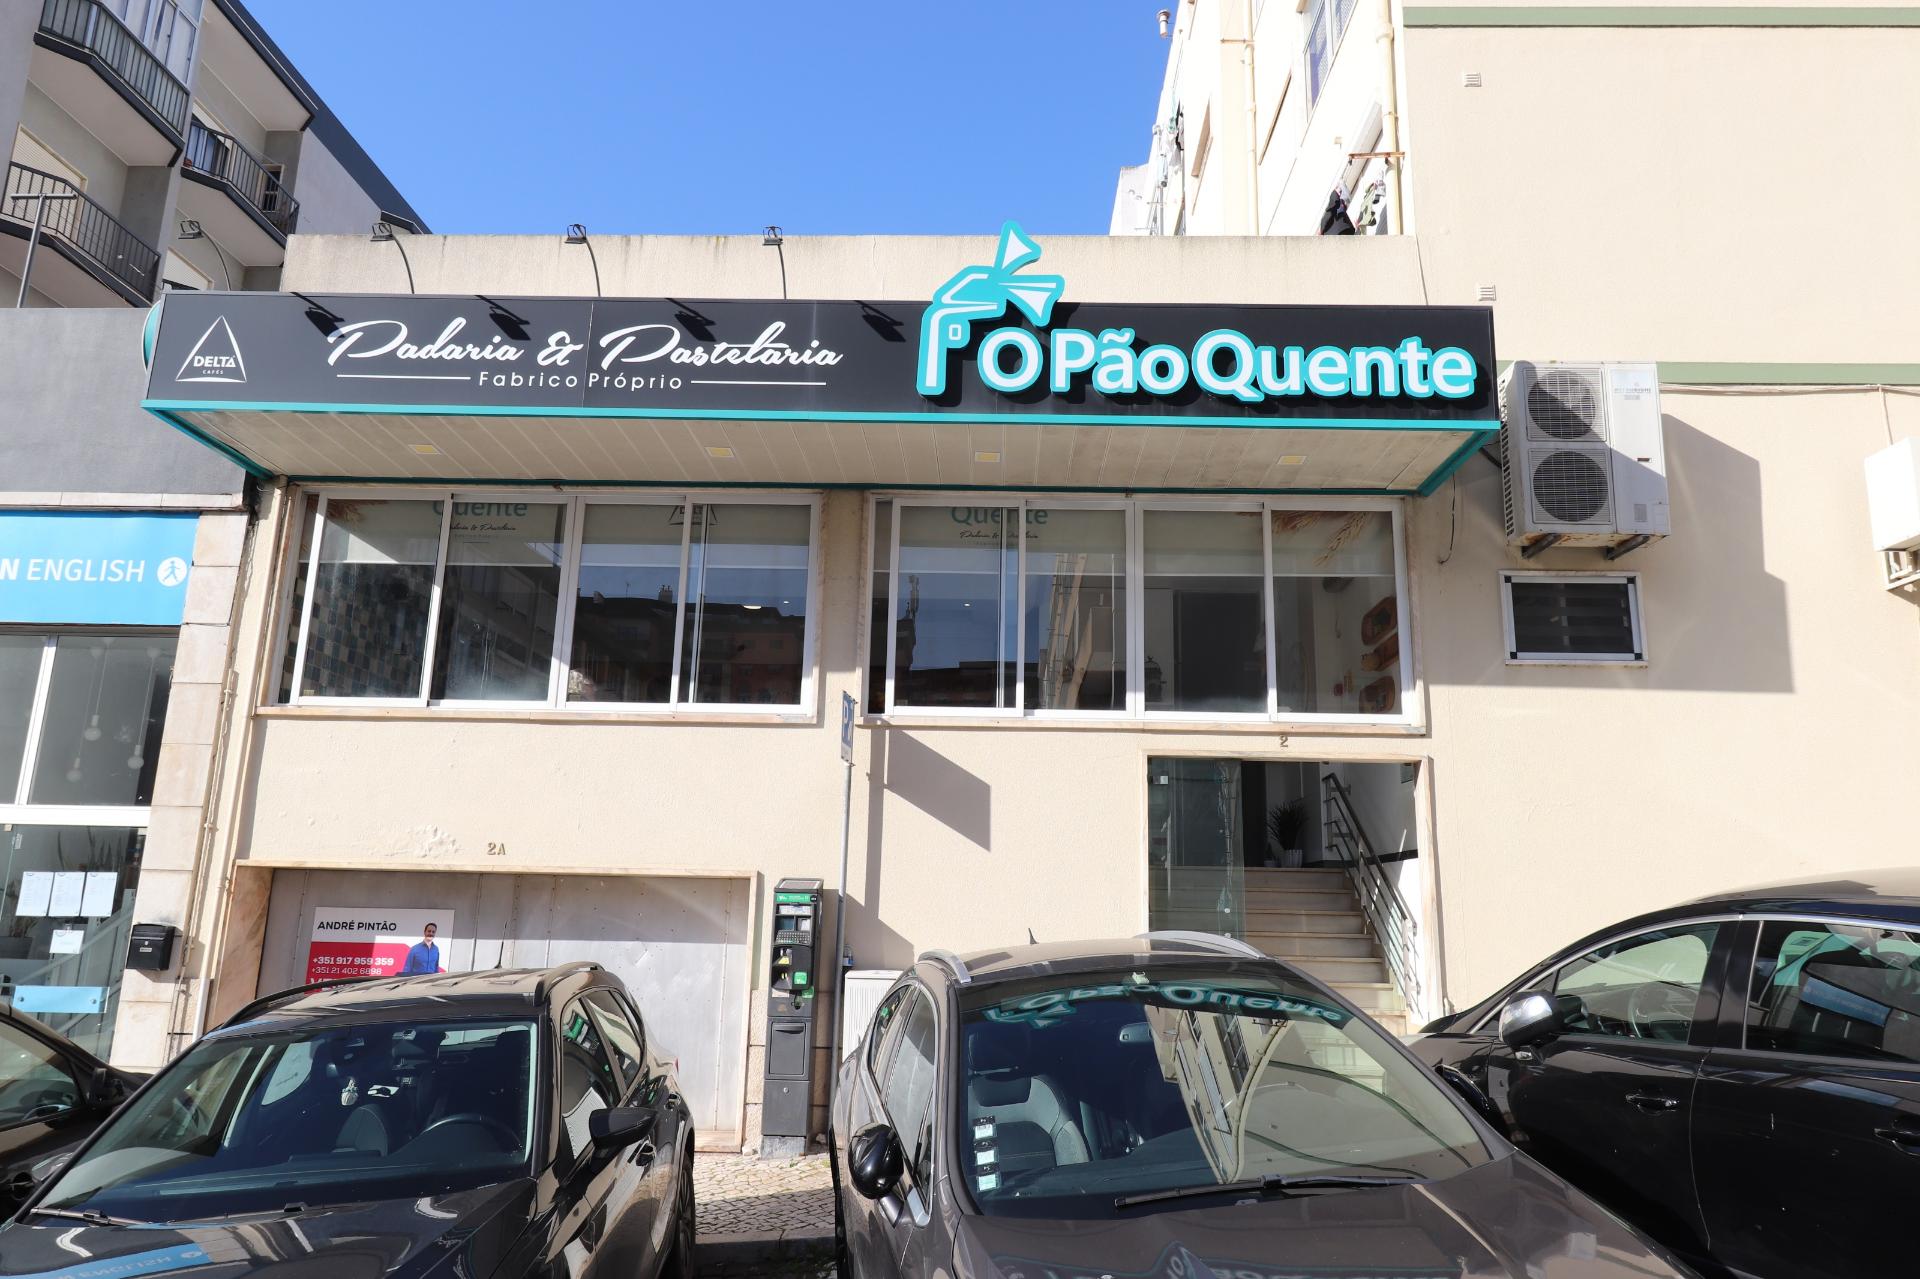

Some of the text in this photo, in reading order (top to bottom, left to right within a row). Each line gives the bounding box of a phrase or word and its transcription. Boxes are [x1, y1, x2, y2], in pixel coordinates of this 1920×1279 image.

[327, 317, 844, 371] Padaria & Pastelaria
[193, 355, 237, 368] DELTA
[1191, 328, 1478, 402] Quente
[479, 371, 682, 391] Fabrico Próprio
[26, 558, 146, 583] ENGLISH
[1280, 735, 1289, 748] 2
[487, 842, 506, 855] 2A
[317, 920, 397, 931] ANDRÉ PINTÃO
[313, 956, 334, 965] +351
[336, 957, 352, 965] 917
[354, 957, 373, 965] 959
[312, 966, 329, 974] +351
